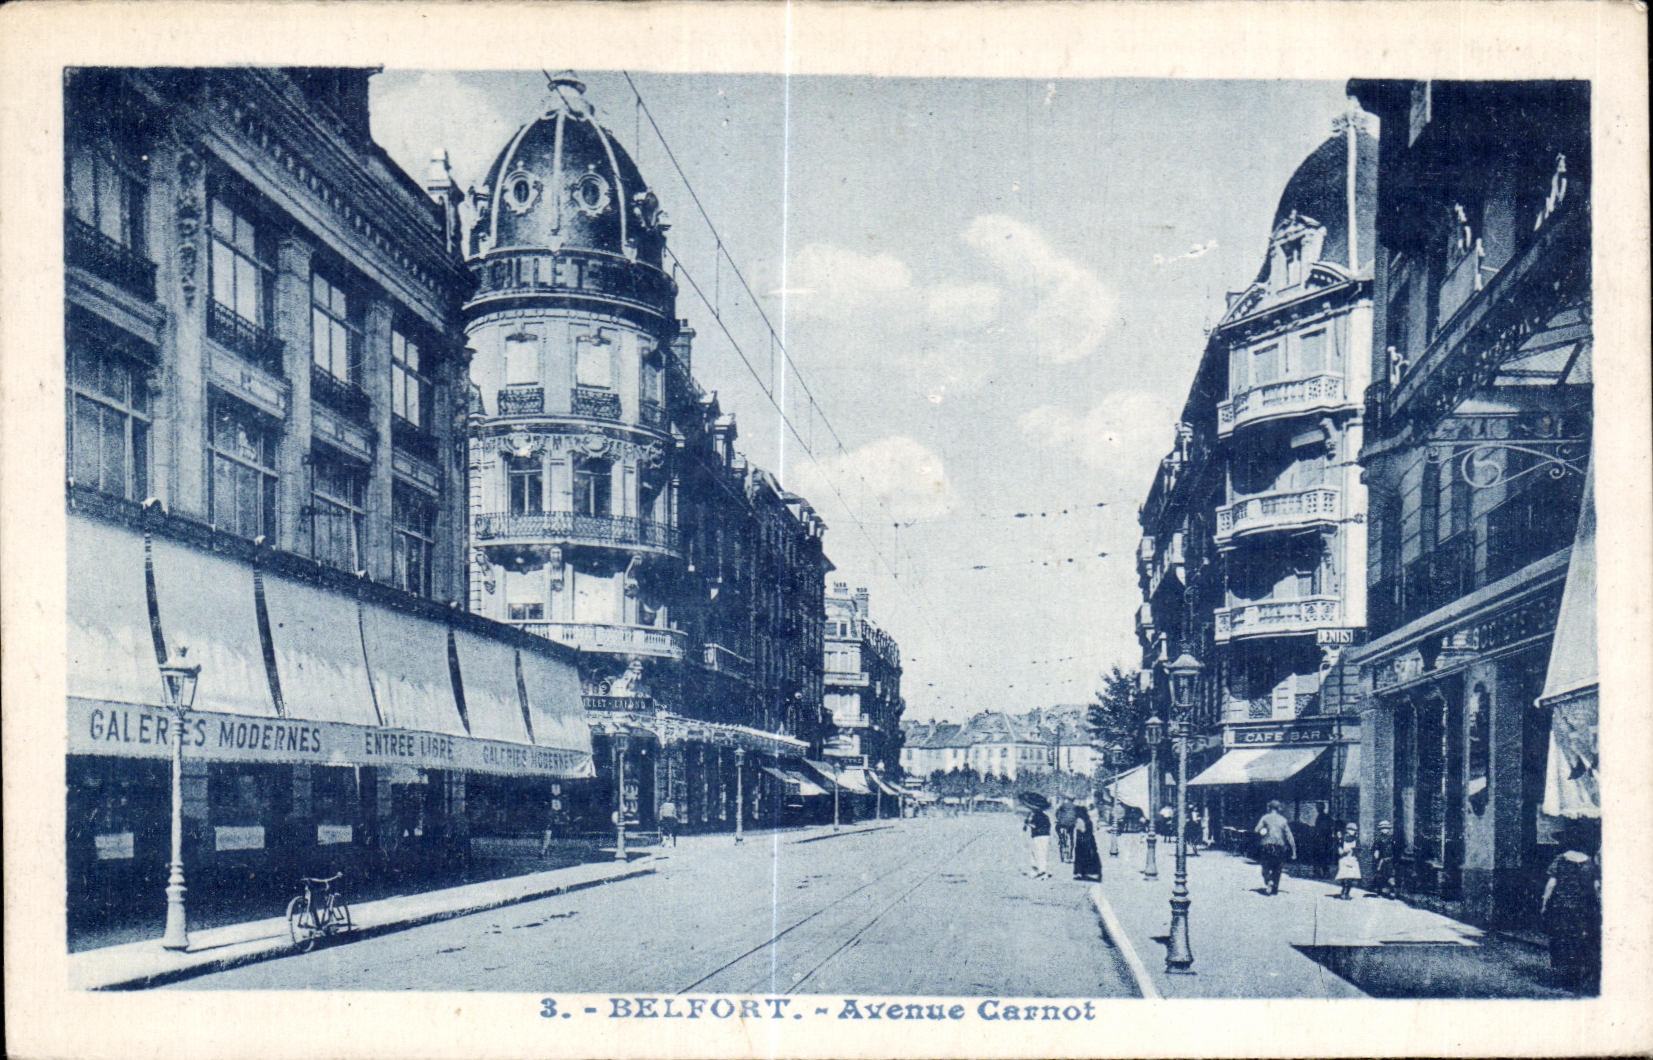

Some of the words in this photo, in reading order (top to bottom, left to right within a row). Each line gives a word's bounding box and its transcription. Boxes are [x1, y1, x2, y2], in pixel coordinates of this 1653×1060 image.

[90, 708, 206, 747] GALERES
[218, 720, 321, 753] MODERNES
[419, 735, 454, 760] LIBRE
